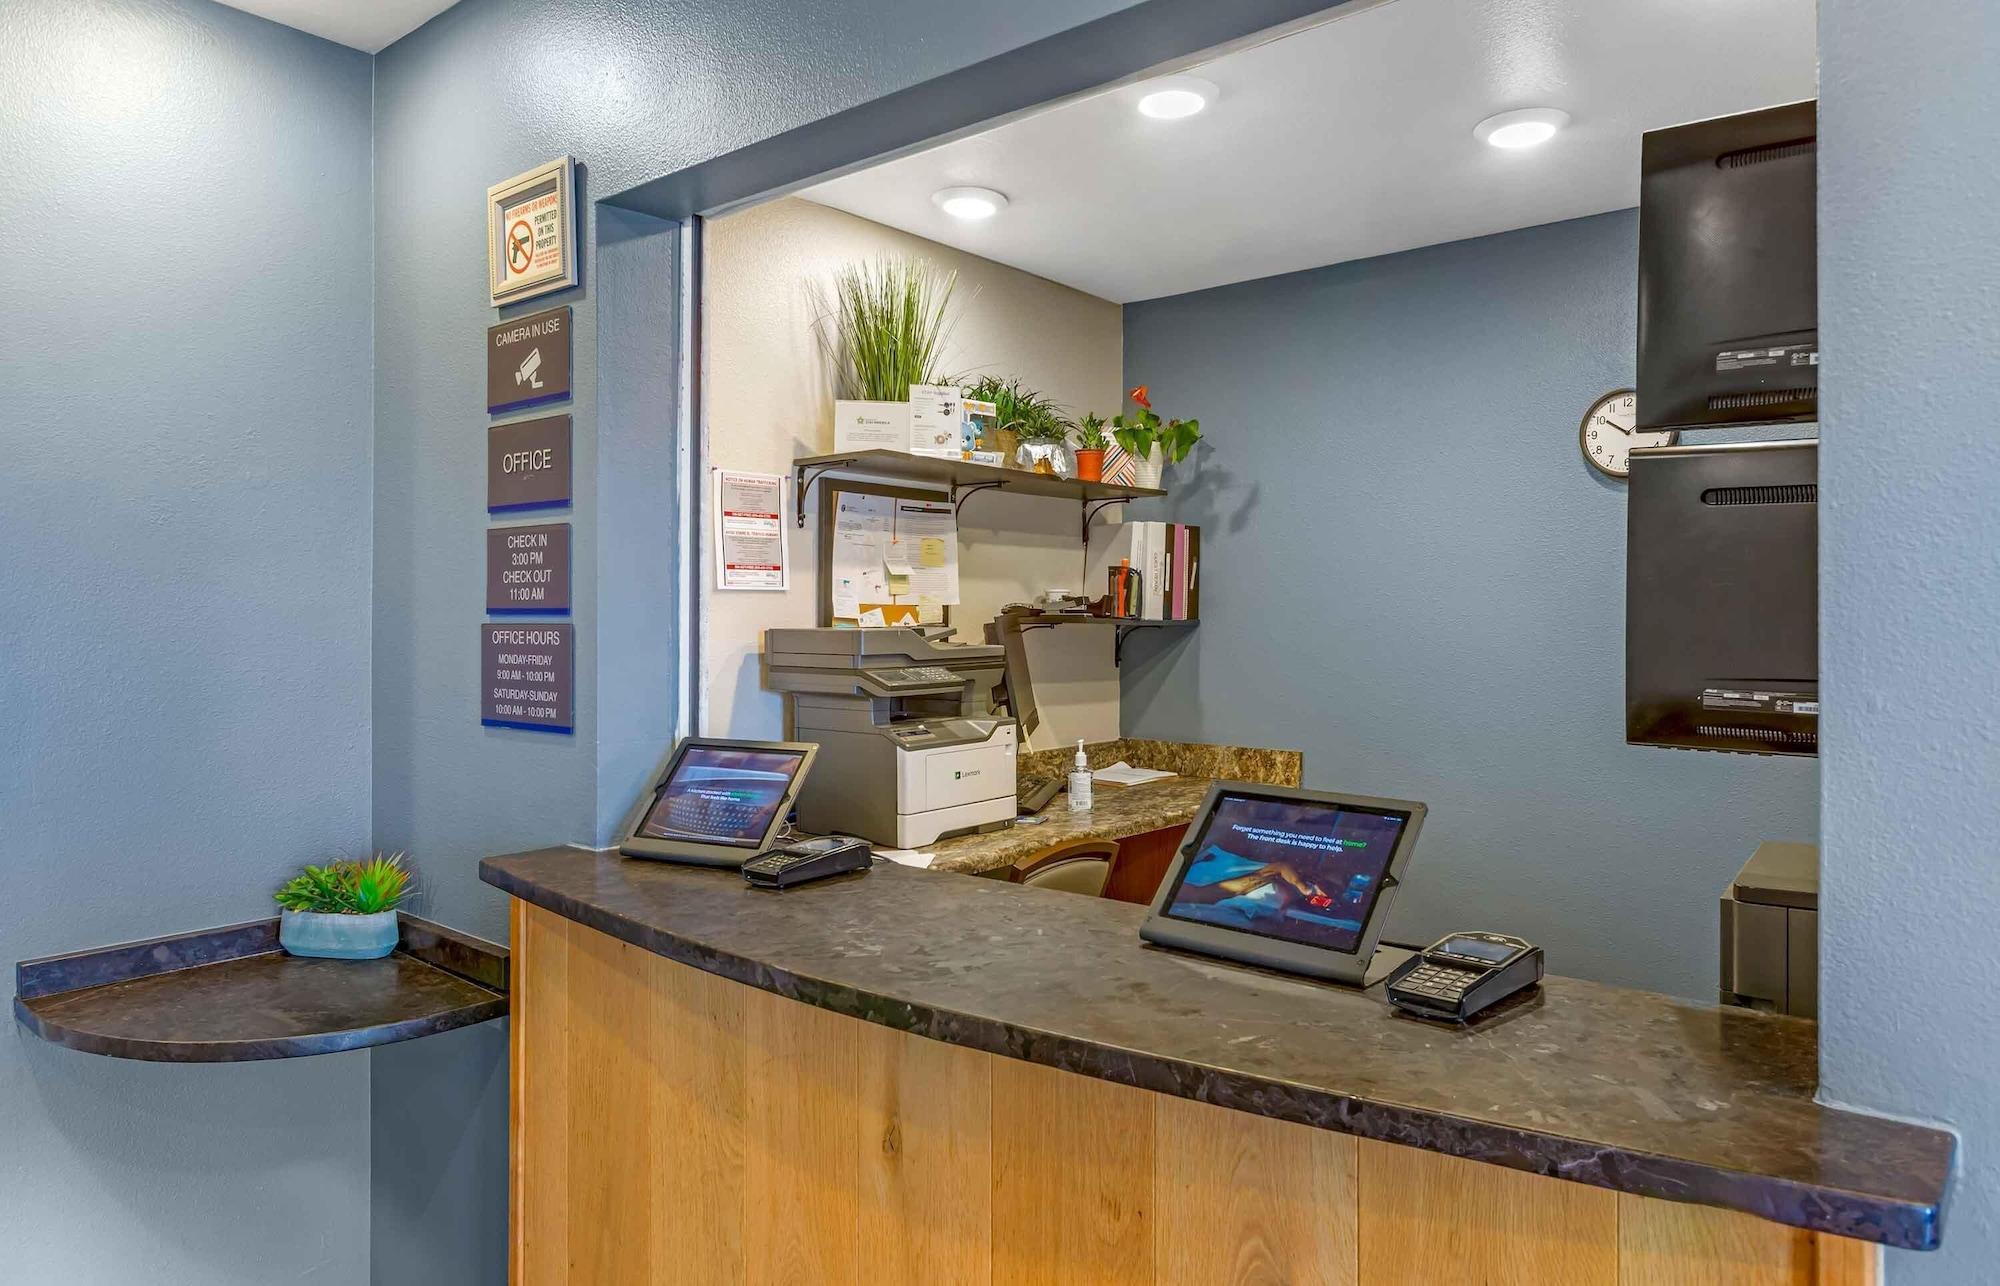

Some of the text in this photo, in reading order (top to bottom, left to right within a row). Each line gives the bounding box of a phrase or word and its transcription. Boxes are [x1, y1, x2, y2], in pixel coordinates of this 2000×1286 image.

[534, 209, 557, 225] PERMITTED
[538, 223, 554, 237] ON THIS
[535, 235, 557, 250] PROPERTY
[495, 318, 560, 347] CAMERA IN USE
[1609, 403, 1615, 413] 11
[1623, 398, 1633, 407] 12
[1596, 415, 1606, 425] 10
[1591, 430, 1598, 440] 9
[1595, 445, 1603, 455] 8
[502, 448, 552, 473] OFFICE
[1608, 454, 1615, 464] 7
[507, 533, 548, 548] CHECK IN
[511, 551, 543, 565] 3:00 PM
[502, 569, 553, 584] CHECK OUT
[510, 587, 545, 600] 11:00 AM
[491, 630, 560, 646] OFFICE HOURS
[498, 653, 553, 666] MONDAY-FRIDAY
[496, 669, 510, 680] 9:00
[510, 670, 521, 680] AM
[526, 671, 543, 681] 10:00
[544, 671, 555, 682] PM
[493, 687, 558, 702] SATURDAY-SUNDAY
[495, 704, 511, 715] 10:00
[512, 705, 523, 716] AM
[527, 706, 545, 718] 10:00
[545, 707, 557, 719] PM
[1232, 824, 1252, 833] Forget
[1252, 827, 1285, 838] something
[1322, 836, 1335, 844] feel
[1343, 839, 1367, 849] home?
[1259, 835, 1276, 843] front
[1275, 837, 1291, 845] desk
[1297, 840, 1318, 850] happy
[1326, 844, 1344, 853] help.
